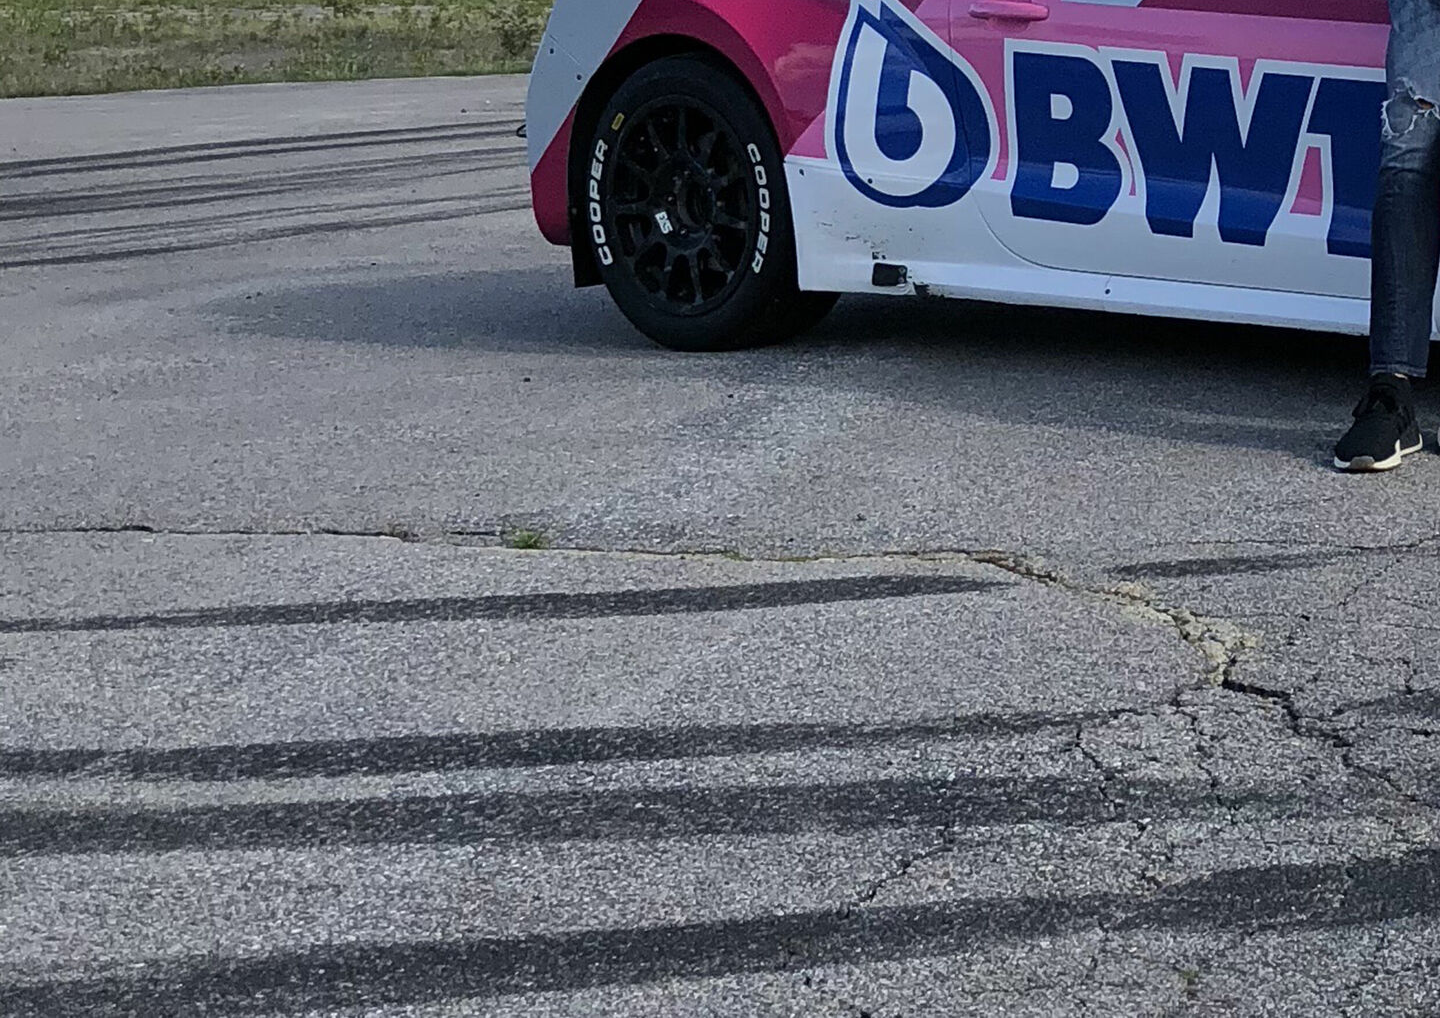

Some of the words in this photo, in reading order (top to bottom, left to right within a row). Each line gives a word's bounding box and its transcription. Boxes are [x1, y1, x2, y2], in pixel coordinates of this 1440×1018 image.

[589, 139, 608, 266] COOPER
[747, 143, 770, 274] COOPER
[1008, 49, 1388, 259] BWT
